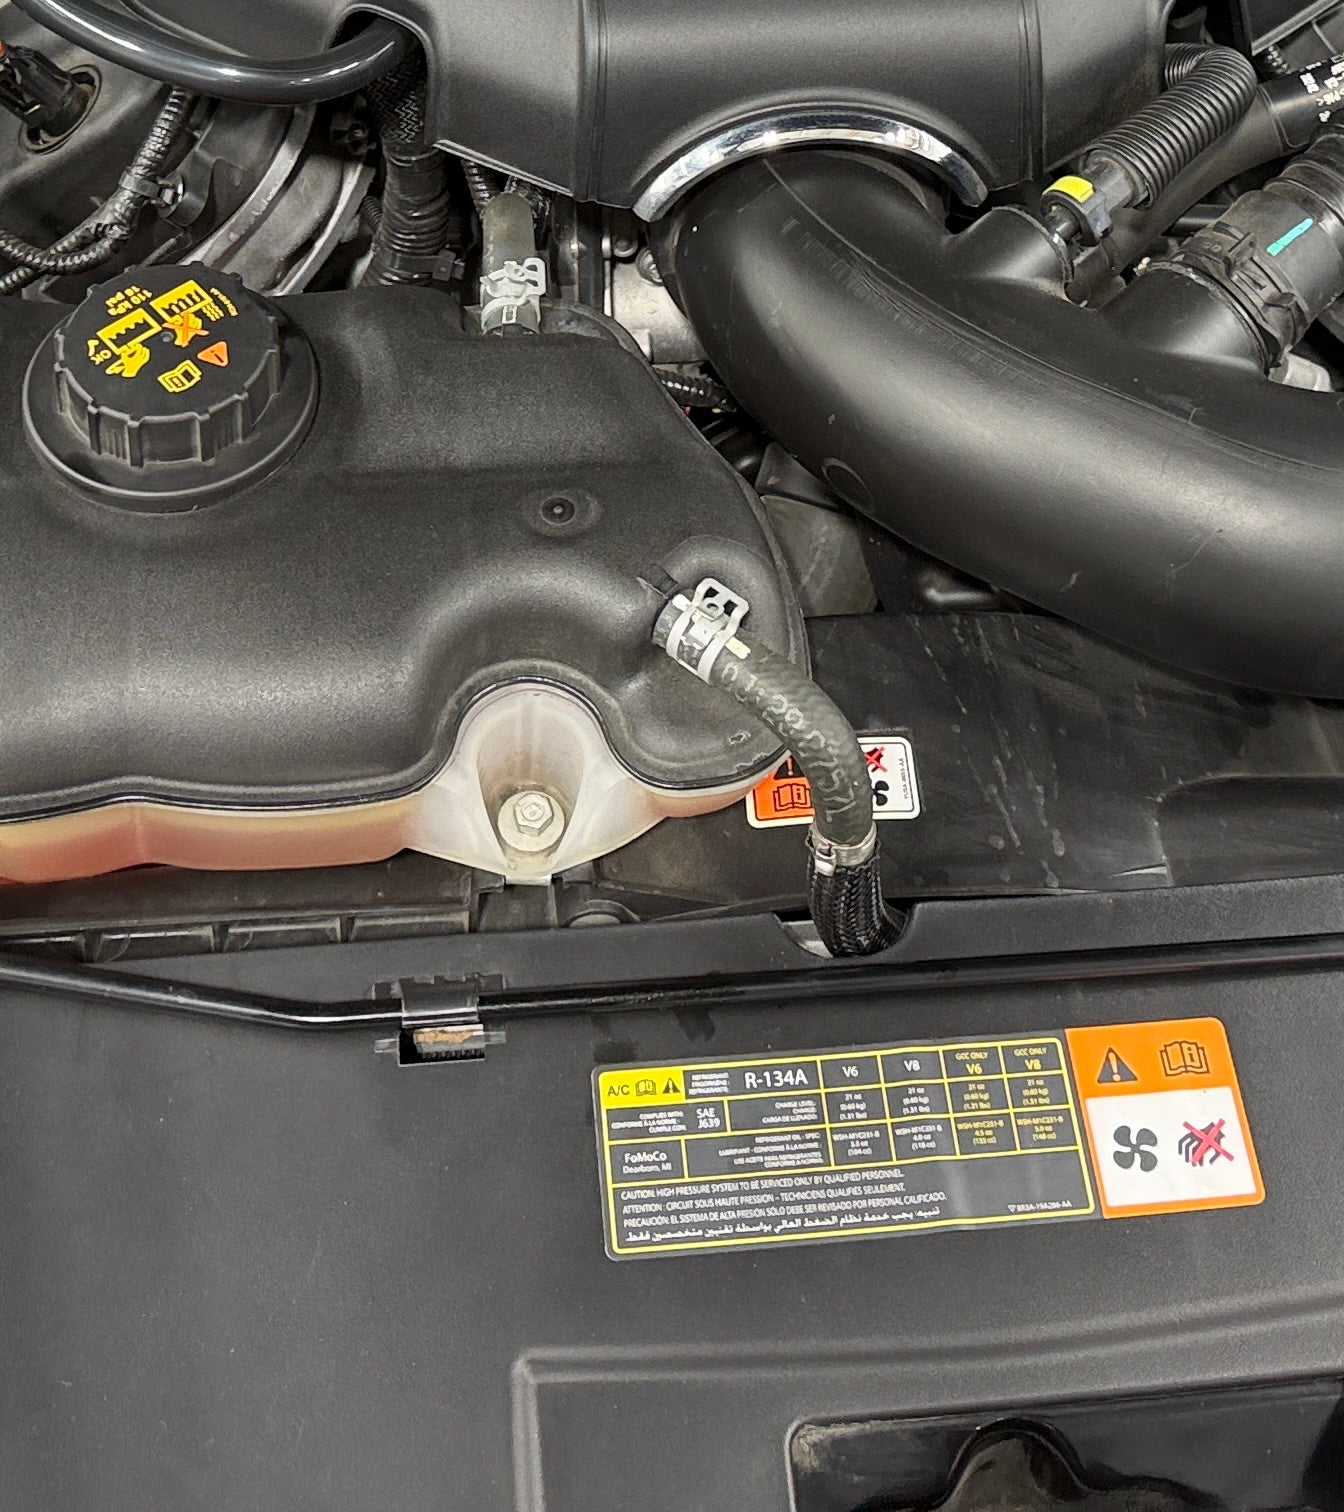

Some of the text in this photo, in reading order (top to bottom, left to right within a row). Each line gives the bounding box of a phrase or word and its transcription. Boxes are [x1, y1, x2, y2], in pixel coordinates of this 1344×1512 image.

[90, 349, 112, 365] OK
[904, 1059, 920, 1071] V8
[966, 1063, 982, 1074] V6
[1025, 1059, 1041, 1070] V8
[842, 1065, 858, 1077] V6
[744, 1068, 808, 1089] R-134A
[607, 1085, 629, 1096] A/C
[696, 1108, 715, 1117] SAE
[697, 1117, 720, 1128] J639
[624, 1150, 667, 1163] FoMoCo
